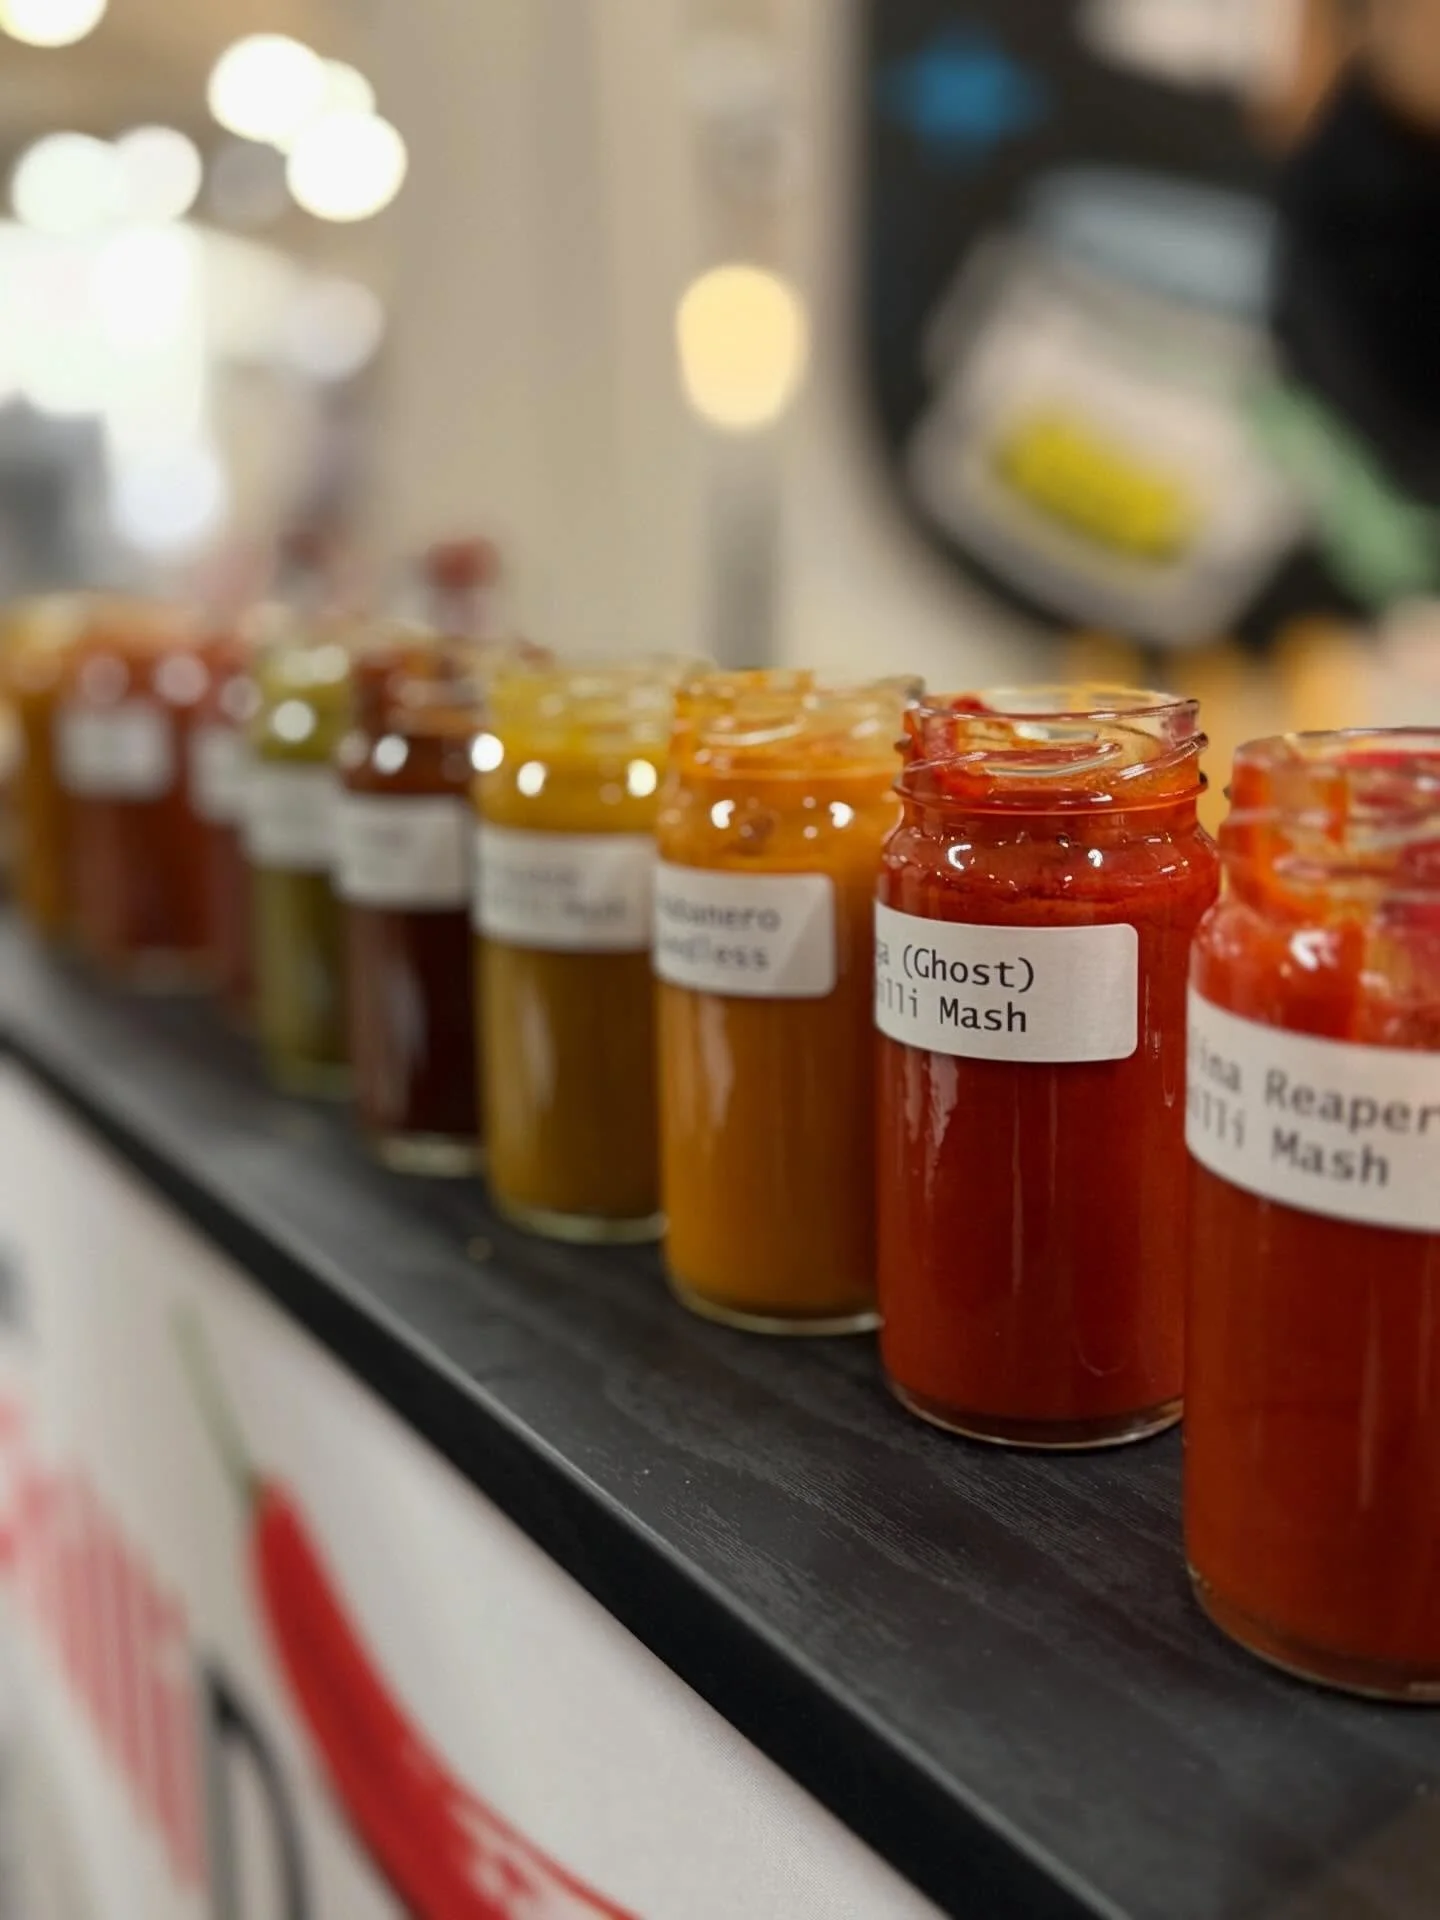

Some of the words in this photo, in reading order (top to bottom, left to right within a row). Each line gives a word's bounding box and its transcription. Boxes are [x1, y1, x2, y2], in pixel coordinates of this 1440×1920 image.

[903, 945, 1034, 993] (Ghost)
[939, 996, 1027, 1033] Mash
[1265, 1068, 1440, 1136] Reaper
[1271, 1125, 1390, 1187] Mash
